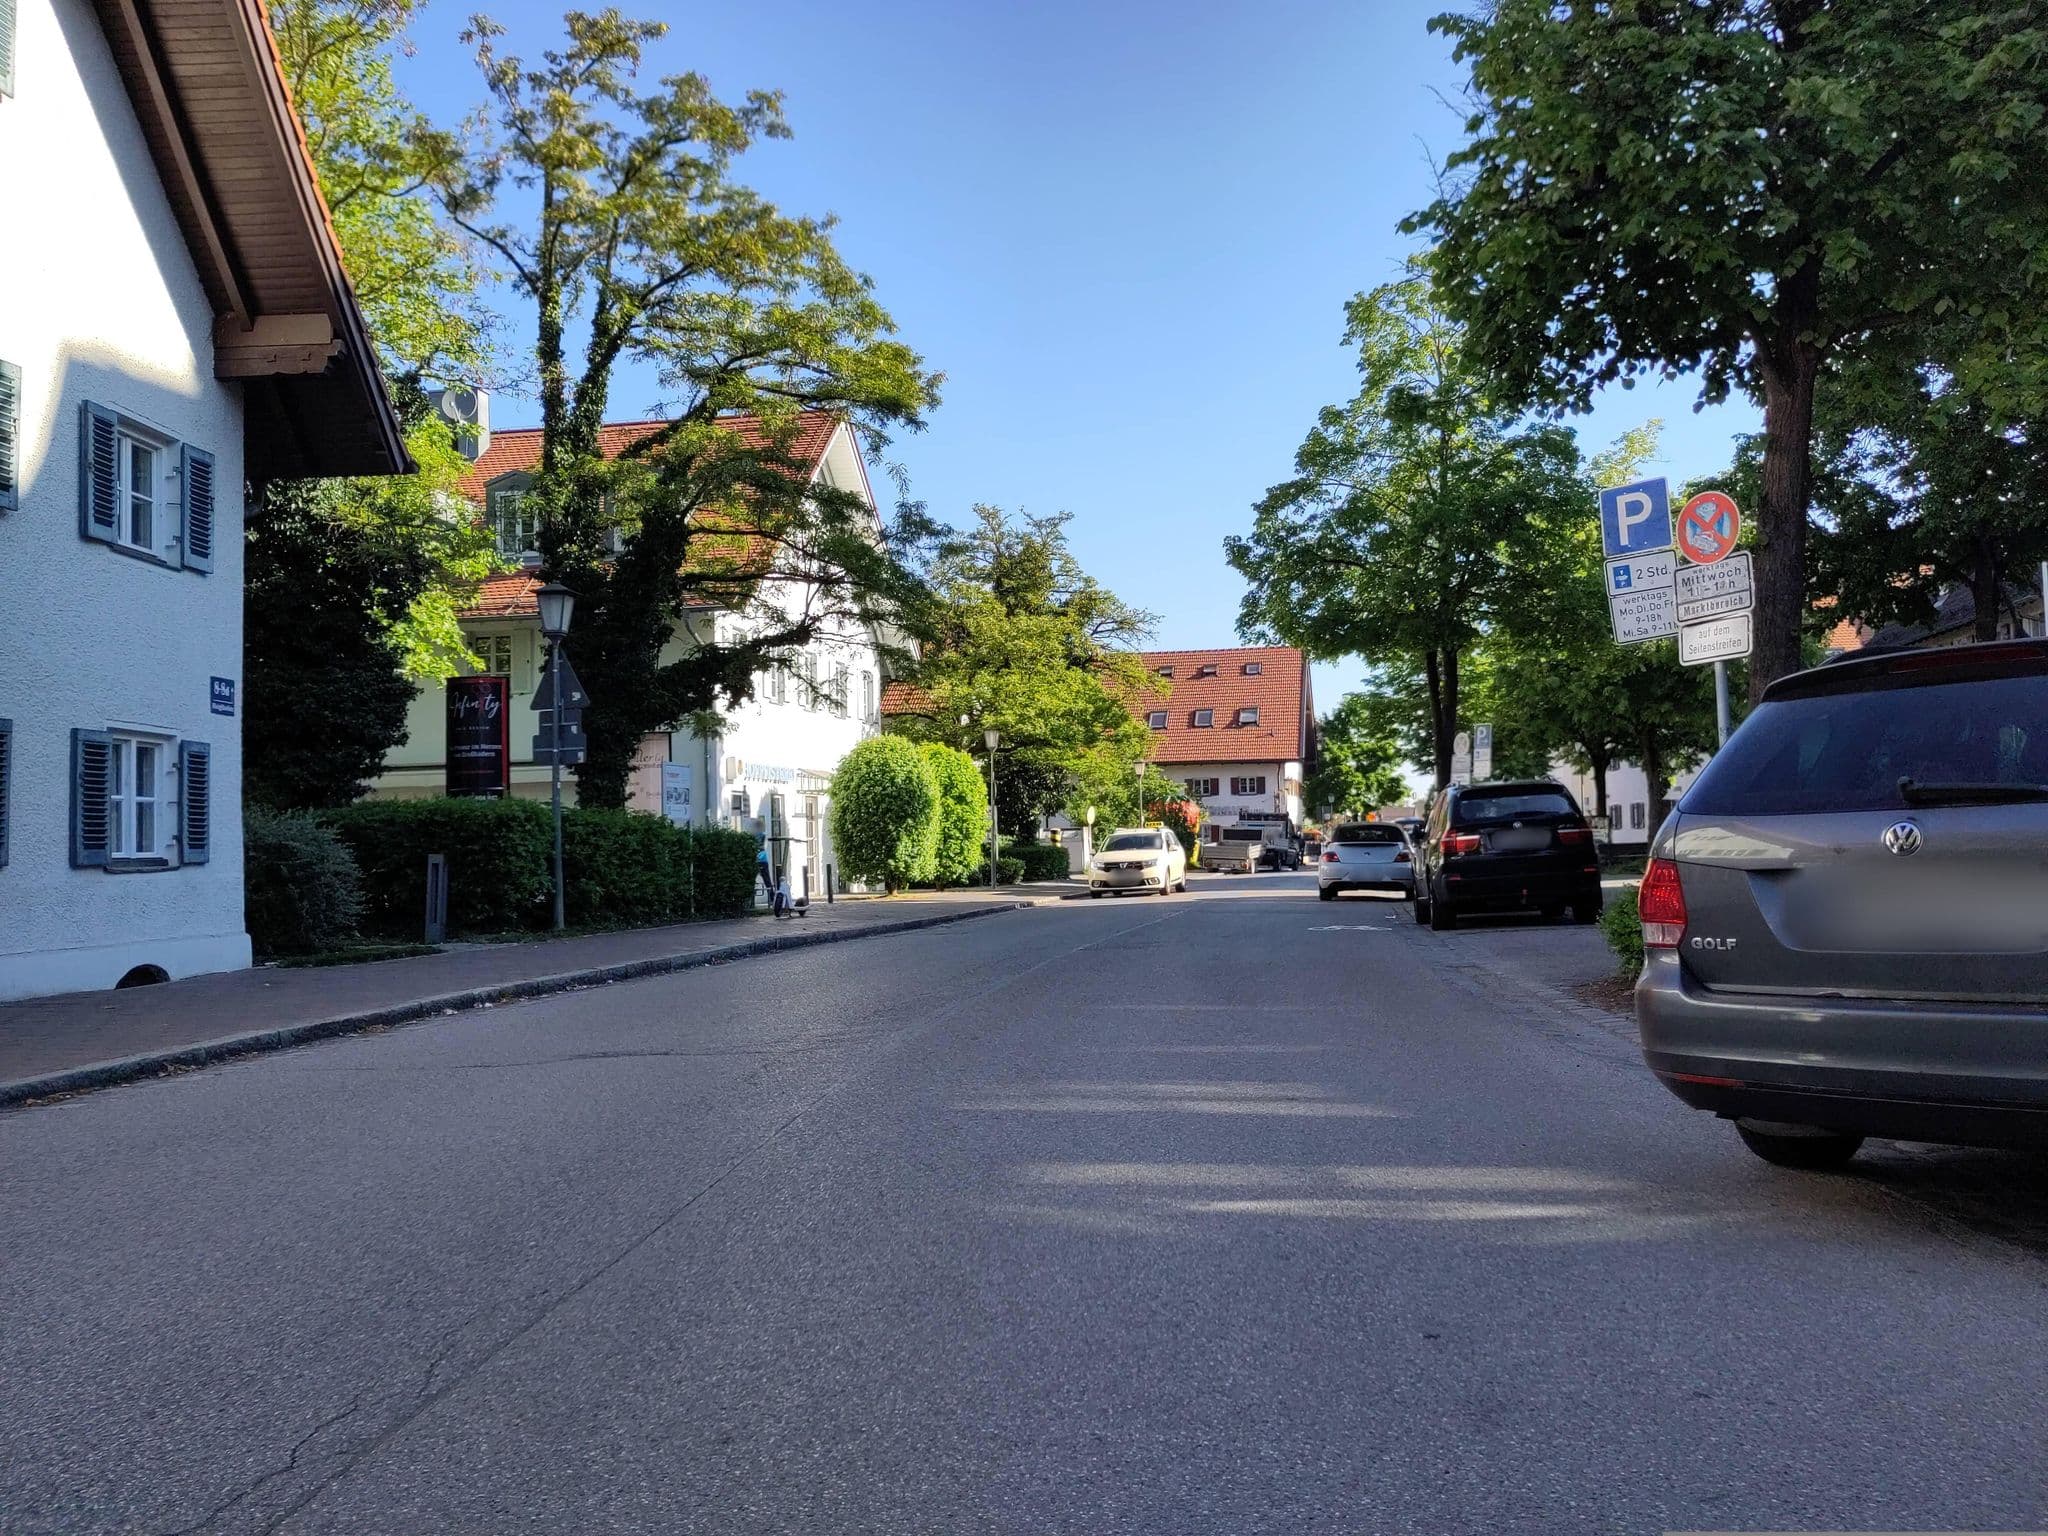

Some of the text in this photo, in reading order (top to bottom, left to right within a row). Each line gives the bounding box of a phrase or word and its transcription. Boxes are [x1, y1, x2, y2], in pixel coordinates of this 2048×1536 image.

[1616, 492, 1652, 546] P
[1636, 564, 1671, 579] 2 Std.
[1681, 566, 1742, 588] Mittwoch
[1623, 591, 1668, 605] werktags
[1683, 595, 1743, 617] Marktbereich
[1698, 624, 1730, 639] auf dem
[1688, 638, 1742, 655] Seitenstreifen
[449, 691, 501, 719] Infinty
[1690, 937, 1737, 950] GOLF
